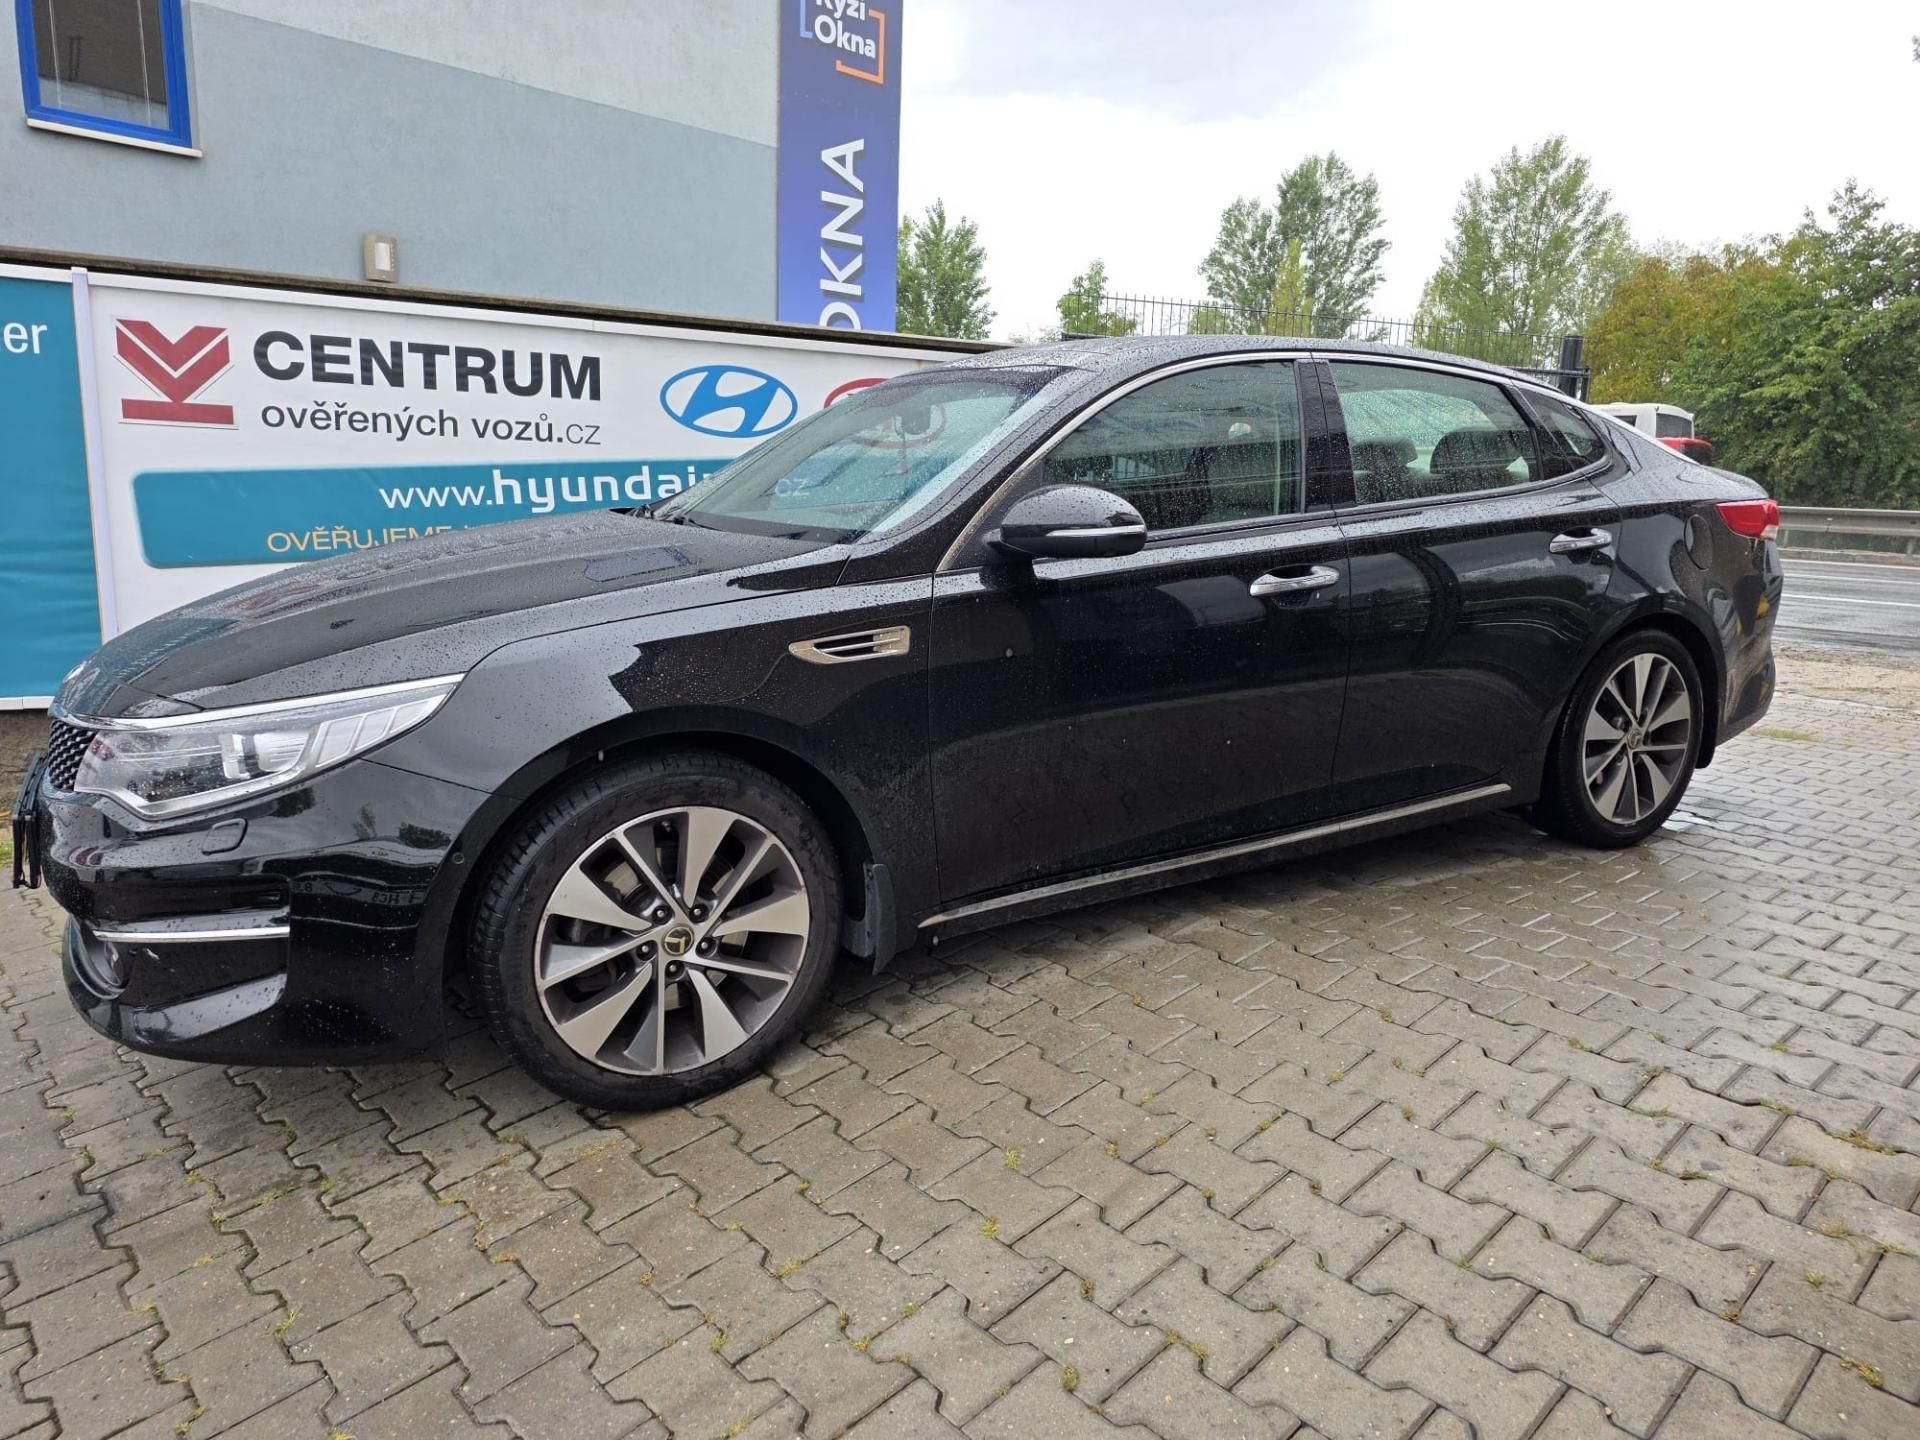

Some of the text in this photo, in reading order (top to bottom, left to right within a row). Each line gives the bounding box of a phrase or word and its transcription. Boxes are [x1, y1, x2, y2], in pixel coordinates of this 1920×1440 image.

[814, 14, 876, 59] Okna
[253, 330, 601, 402] CENTRUM
[261, 400, 459, 442] ověřených
